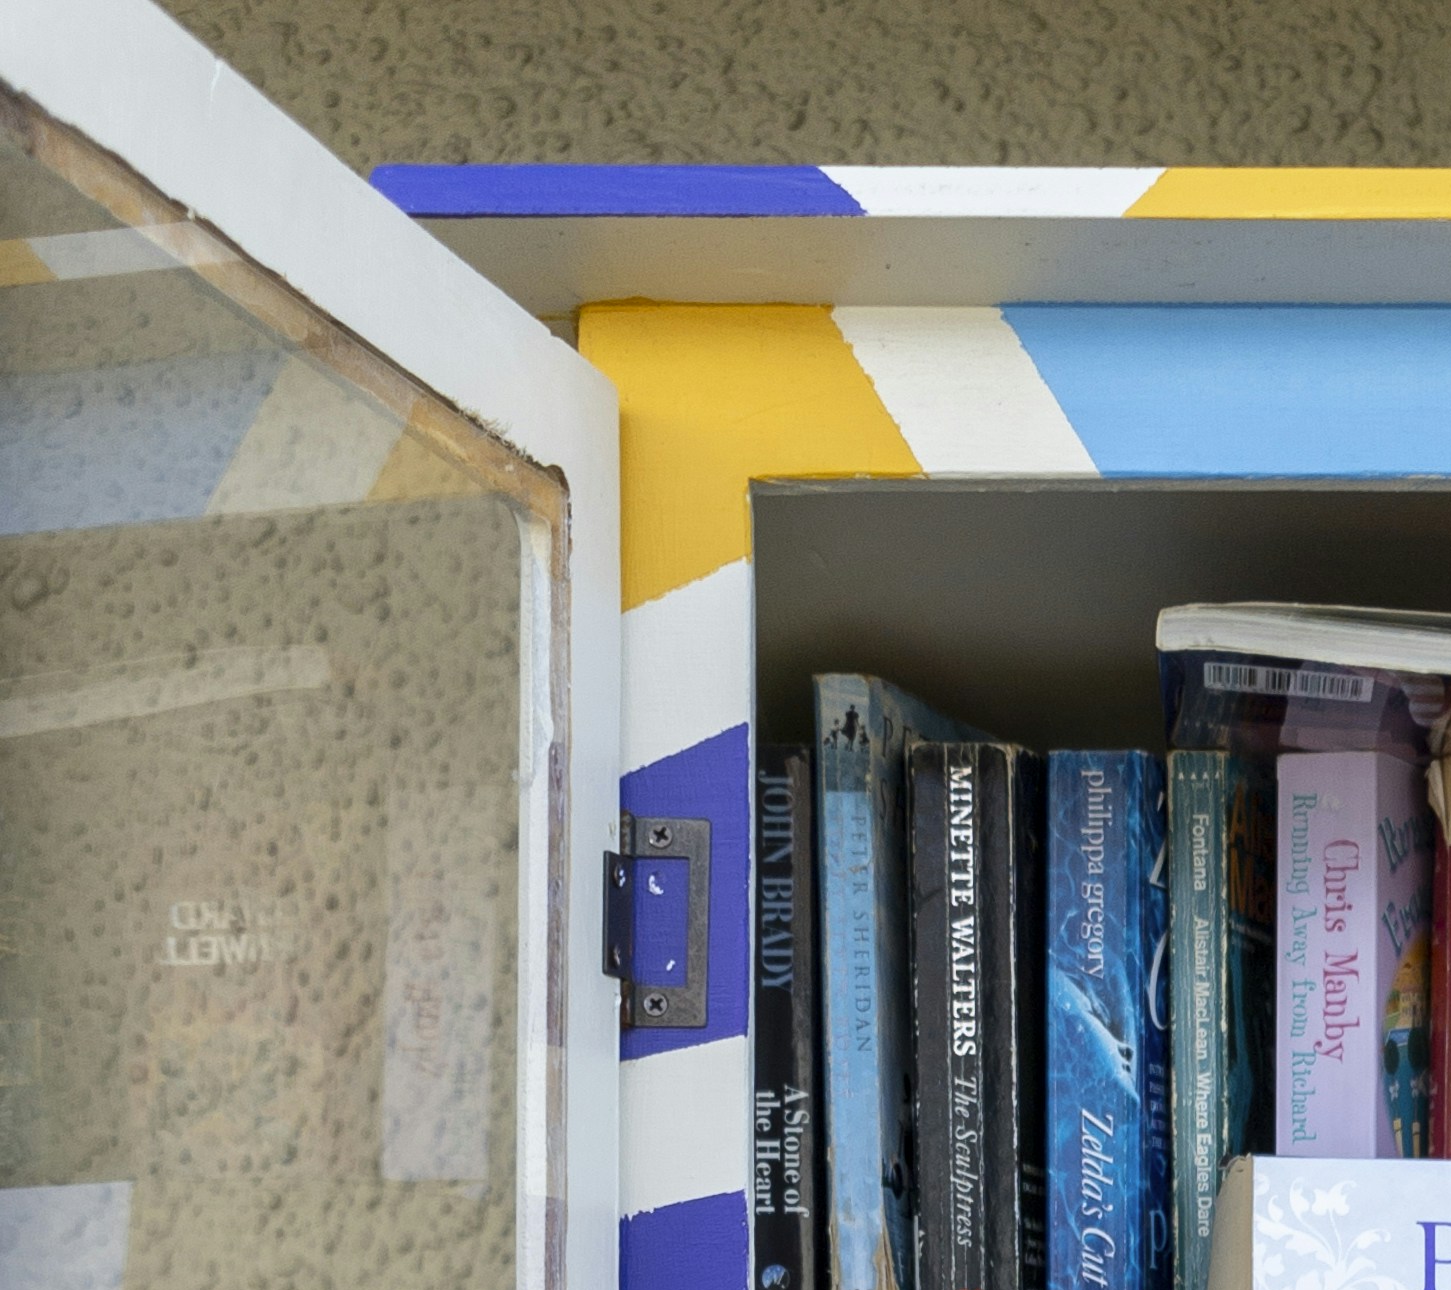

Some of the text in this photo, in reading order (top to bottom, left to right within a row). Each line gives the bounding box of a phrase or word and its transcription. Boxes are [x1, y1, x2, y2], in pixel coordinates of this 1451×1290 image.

[758, 770, 793, 992] JOHN BRADY
[851, 816, 874, 1052] PETER SHERIDAN
[1080, 770, 1114, 979] philippa gregory
[1286, 792, 1318, 1144] Running Away from Richard
[1314, 838, 1360, 1065] Chris Manby
[950, 766, 978, 1248] MINETTE WALTERS The Sculptress
[1192, 813, 1213, 1237] Fontana Alistair MacLean Where Eagles Dare
[755, 1091, 781, 1216] the Heart
[784, 1085, 811, 1218] A Stone of
[1081, 1108, 1114, 1219] Zelda's
[1082, 1227, 1116, 1288] Cut
